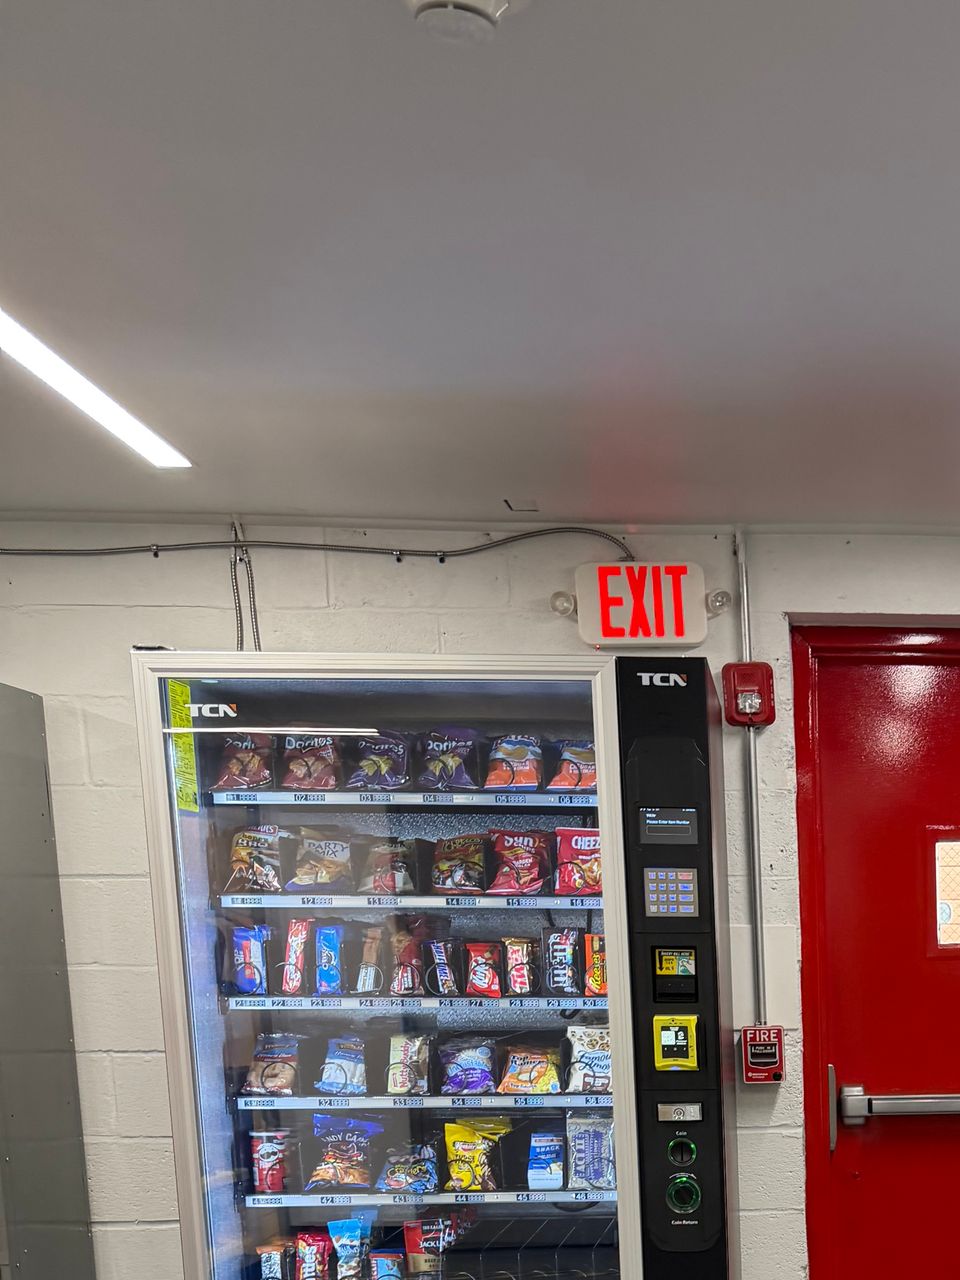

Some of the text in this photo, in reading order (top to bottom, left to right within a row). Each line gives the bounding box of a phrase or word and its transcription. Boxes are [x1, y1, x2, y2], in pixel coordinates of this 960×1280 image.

[597, 565, 688, 638] EXIT
[637, 672, 688, 687] TCN
[185, 703, 238, 717] TCN
[307, 841, 349, 851] PARTY
[315, 849, 337, 857] MIX
[747, 1030, 778, 1041] FIRE
[578, 1050, 611, 1063] Famou
[399, 1040, 412, 1089] Nutty Buddy
